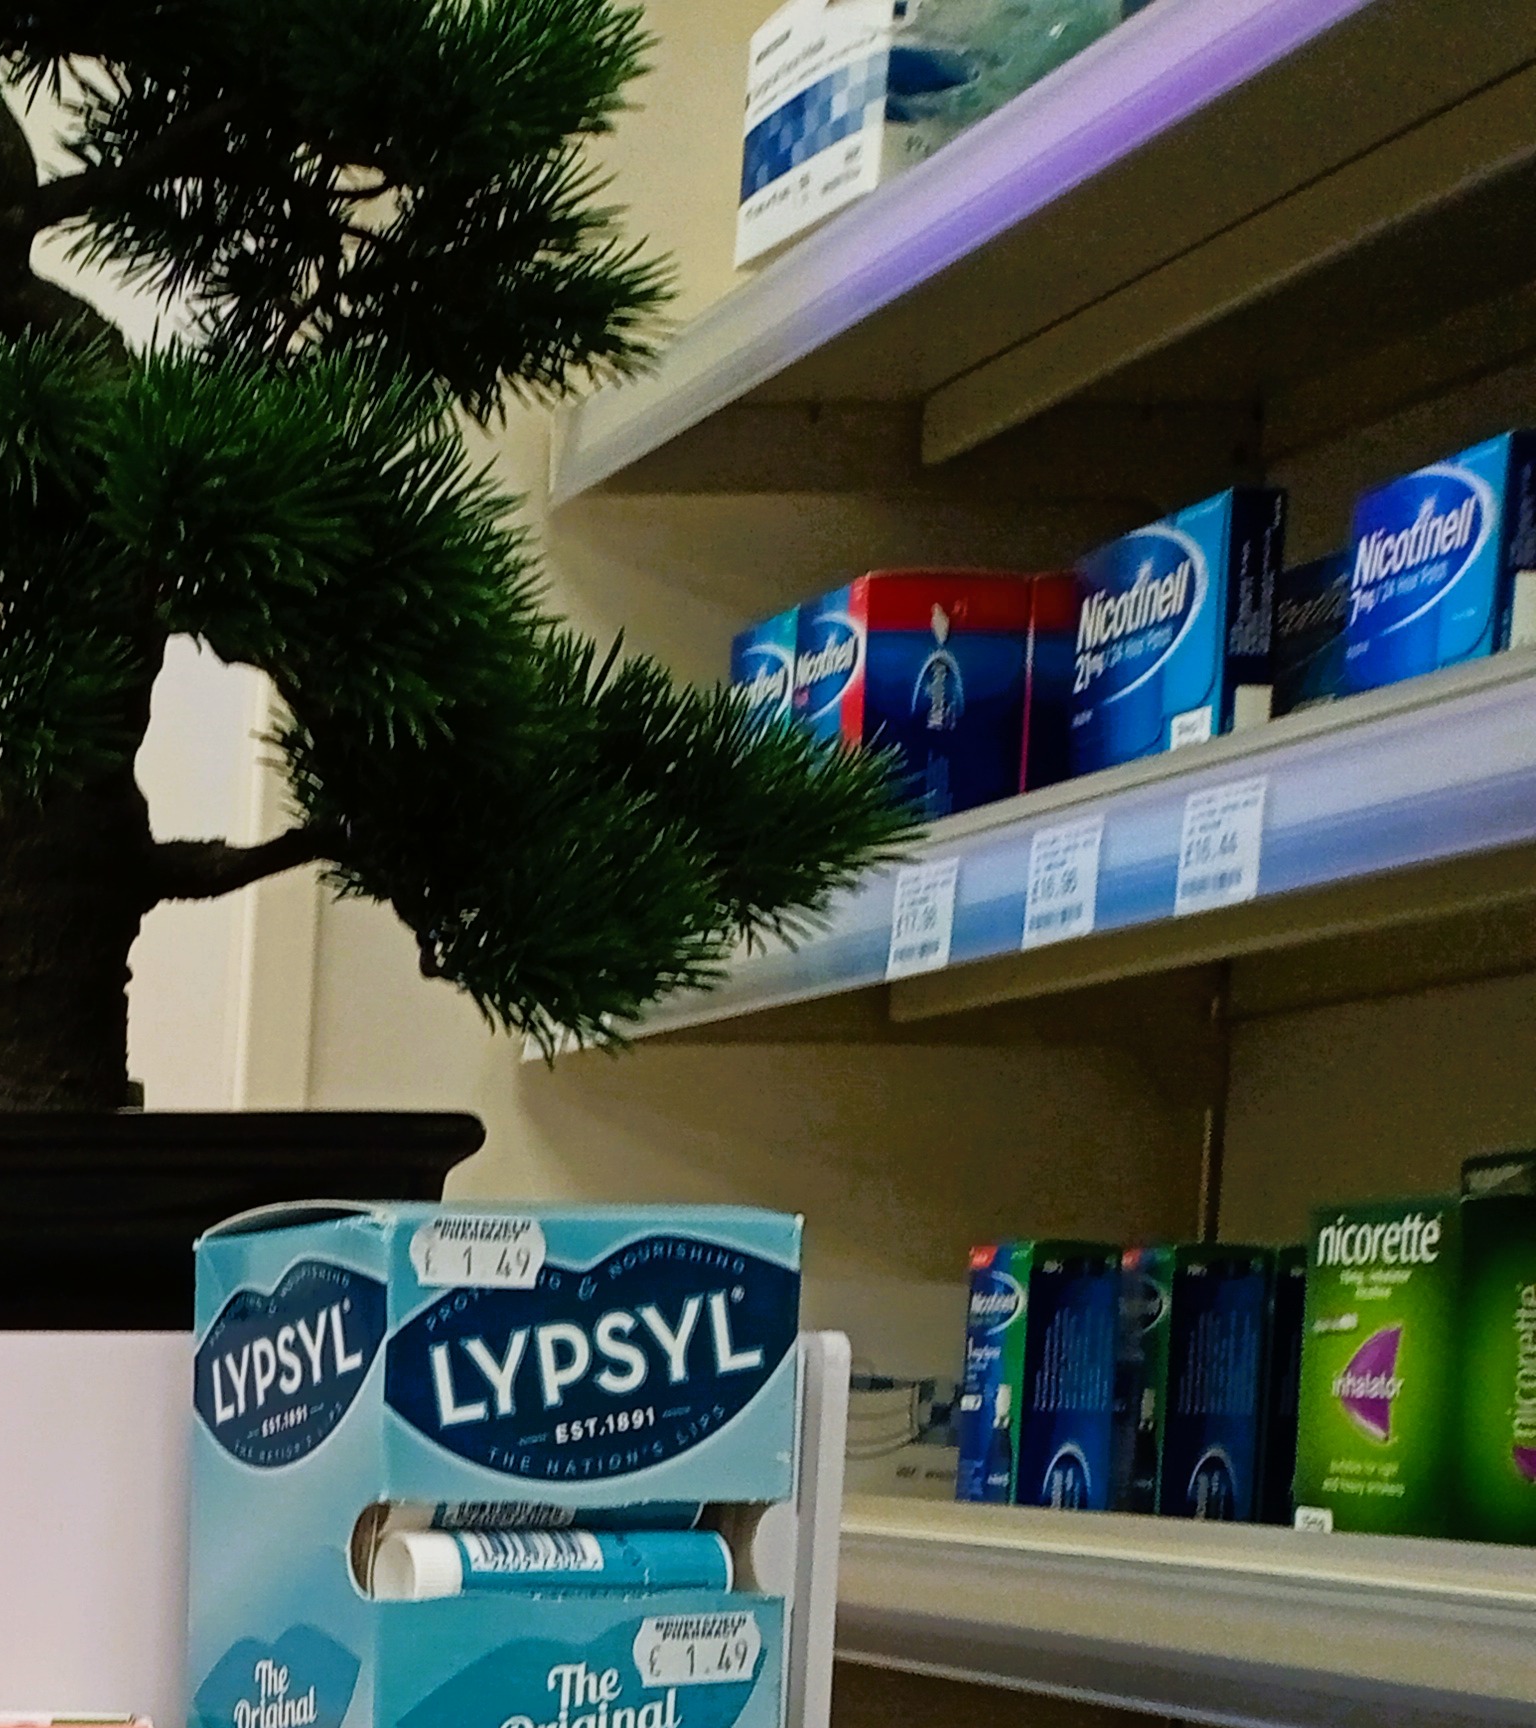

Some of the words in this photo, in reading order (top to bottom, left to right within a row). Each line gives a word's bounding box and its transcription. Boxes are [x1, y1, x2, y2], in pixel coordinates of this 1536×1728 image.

[1353, 494, 1476, 594] Nicotinell
[1078, 558, 1193, 648] Nicotinell
[1316, 1211, 1443, 1268] nicorette
[254, 1658, 291, 1702] The
[547, 1662, 622, 1710] The
